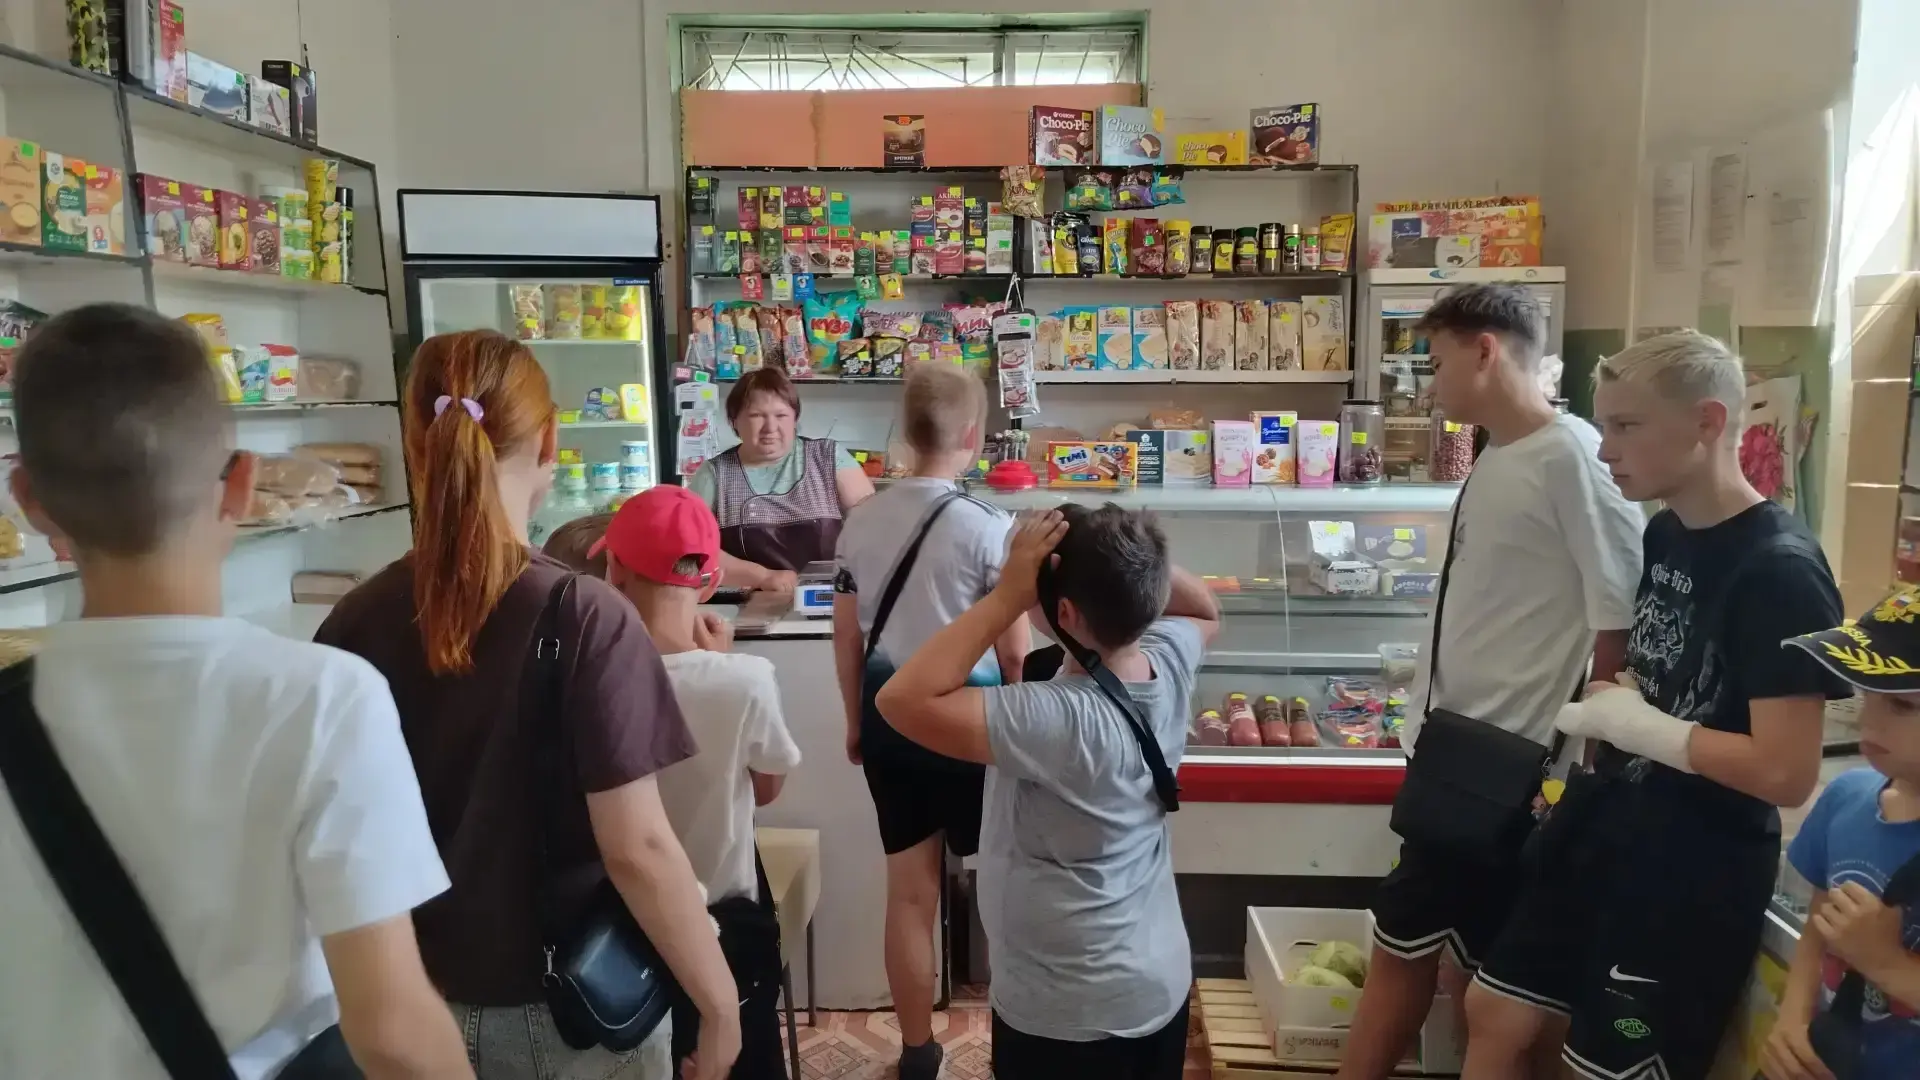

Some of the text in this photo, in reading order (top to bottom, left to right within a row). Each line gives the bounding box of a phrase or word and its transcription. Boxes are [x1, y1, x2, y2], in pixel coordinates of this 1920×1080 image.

[1106, 117, 1147, 134] Choco
[1109, 132, 1130, 149] Pie
[1181, 150, 1198, 162] Pie
[1384, 203, 1419, 213] SUPER
[1420, 200, 1472, 211] PREMIUM
